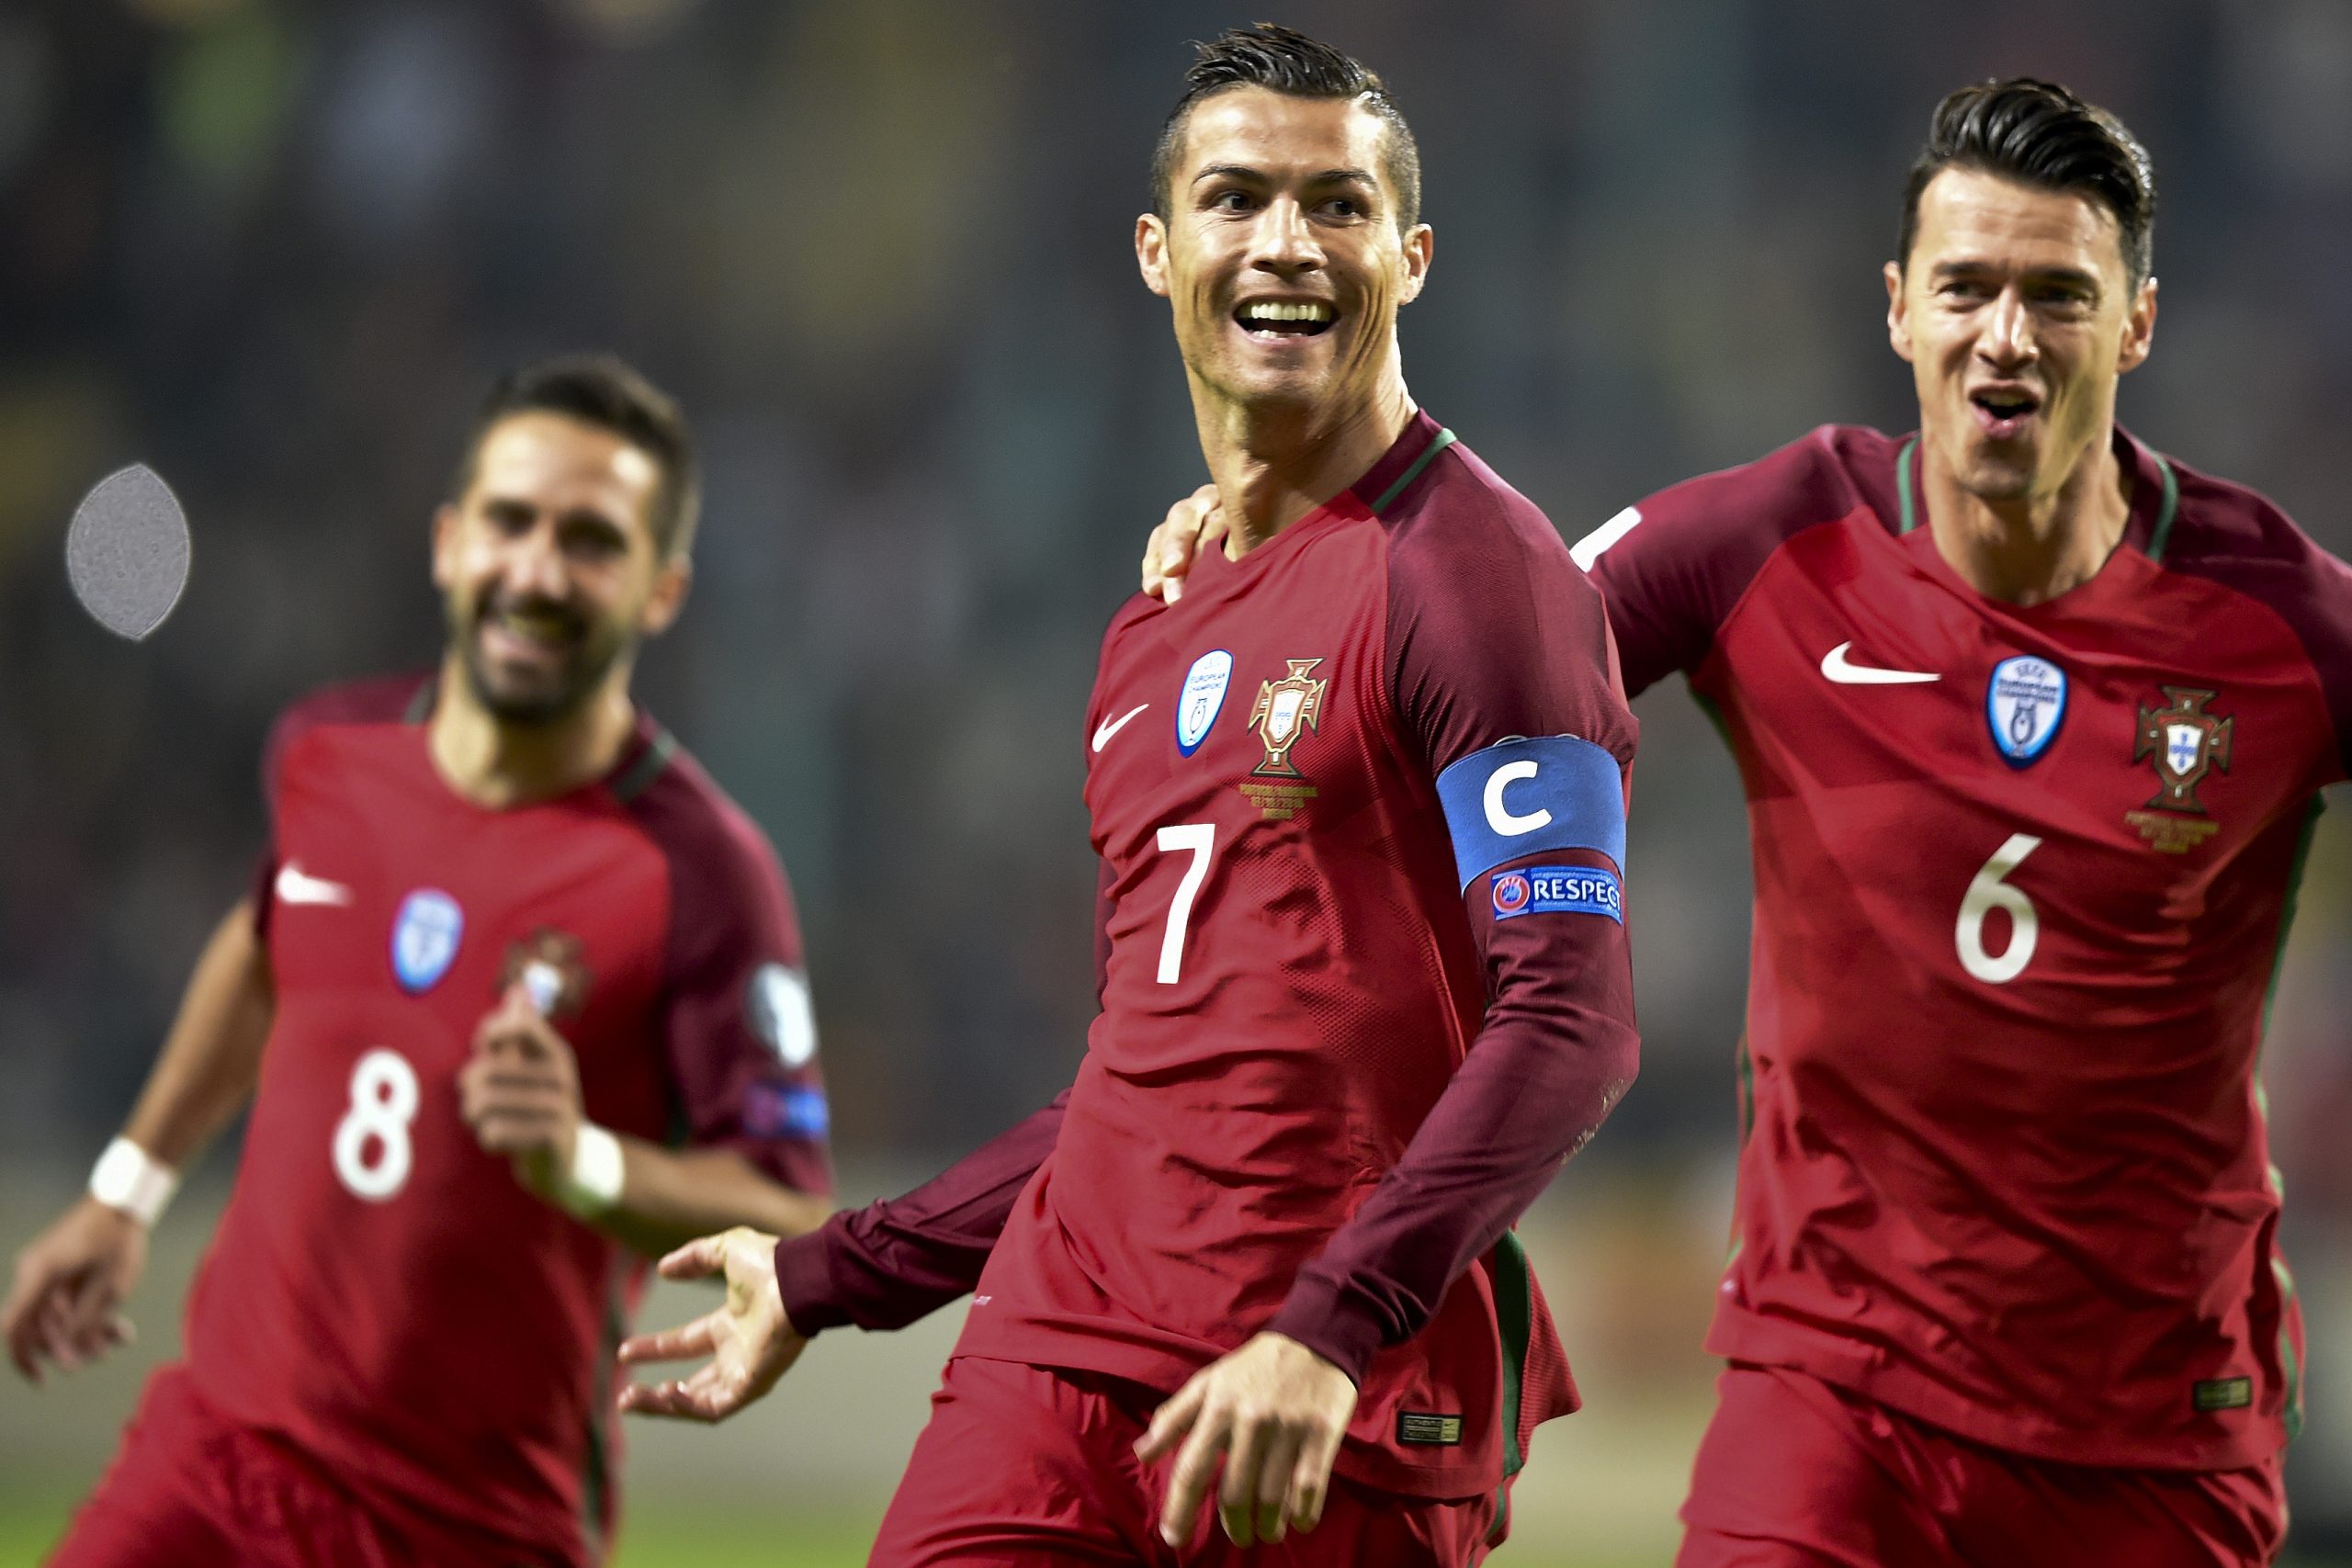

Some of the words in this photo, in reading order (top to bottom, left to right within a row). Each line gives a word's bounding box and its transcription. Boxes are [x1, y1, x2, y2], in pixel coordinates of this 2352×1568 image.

[1483, 761, 1553, 837] C
[1157, 823, 1216, 984] 7
[1955, 832, 2044, 984] 6
[332, 1048, 422, 1202] 8
